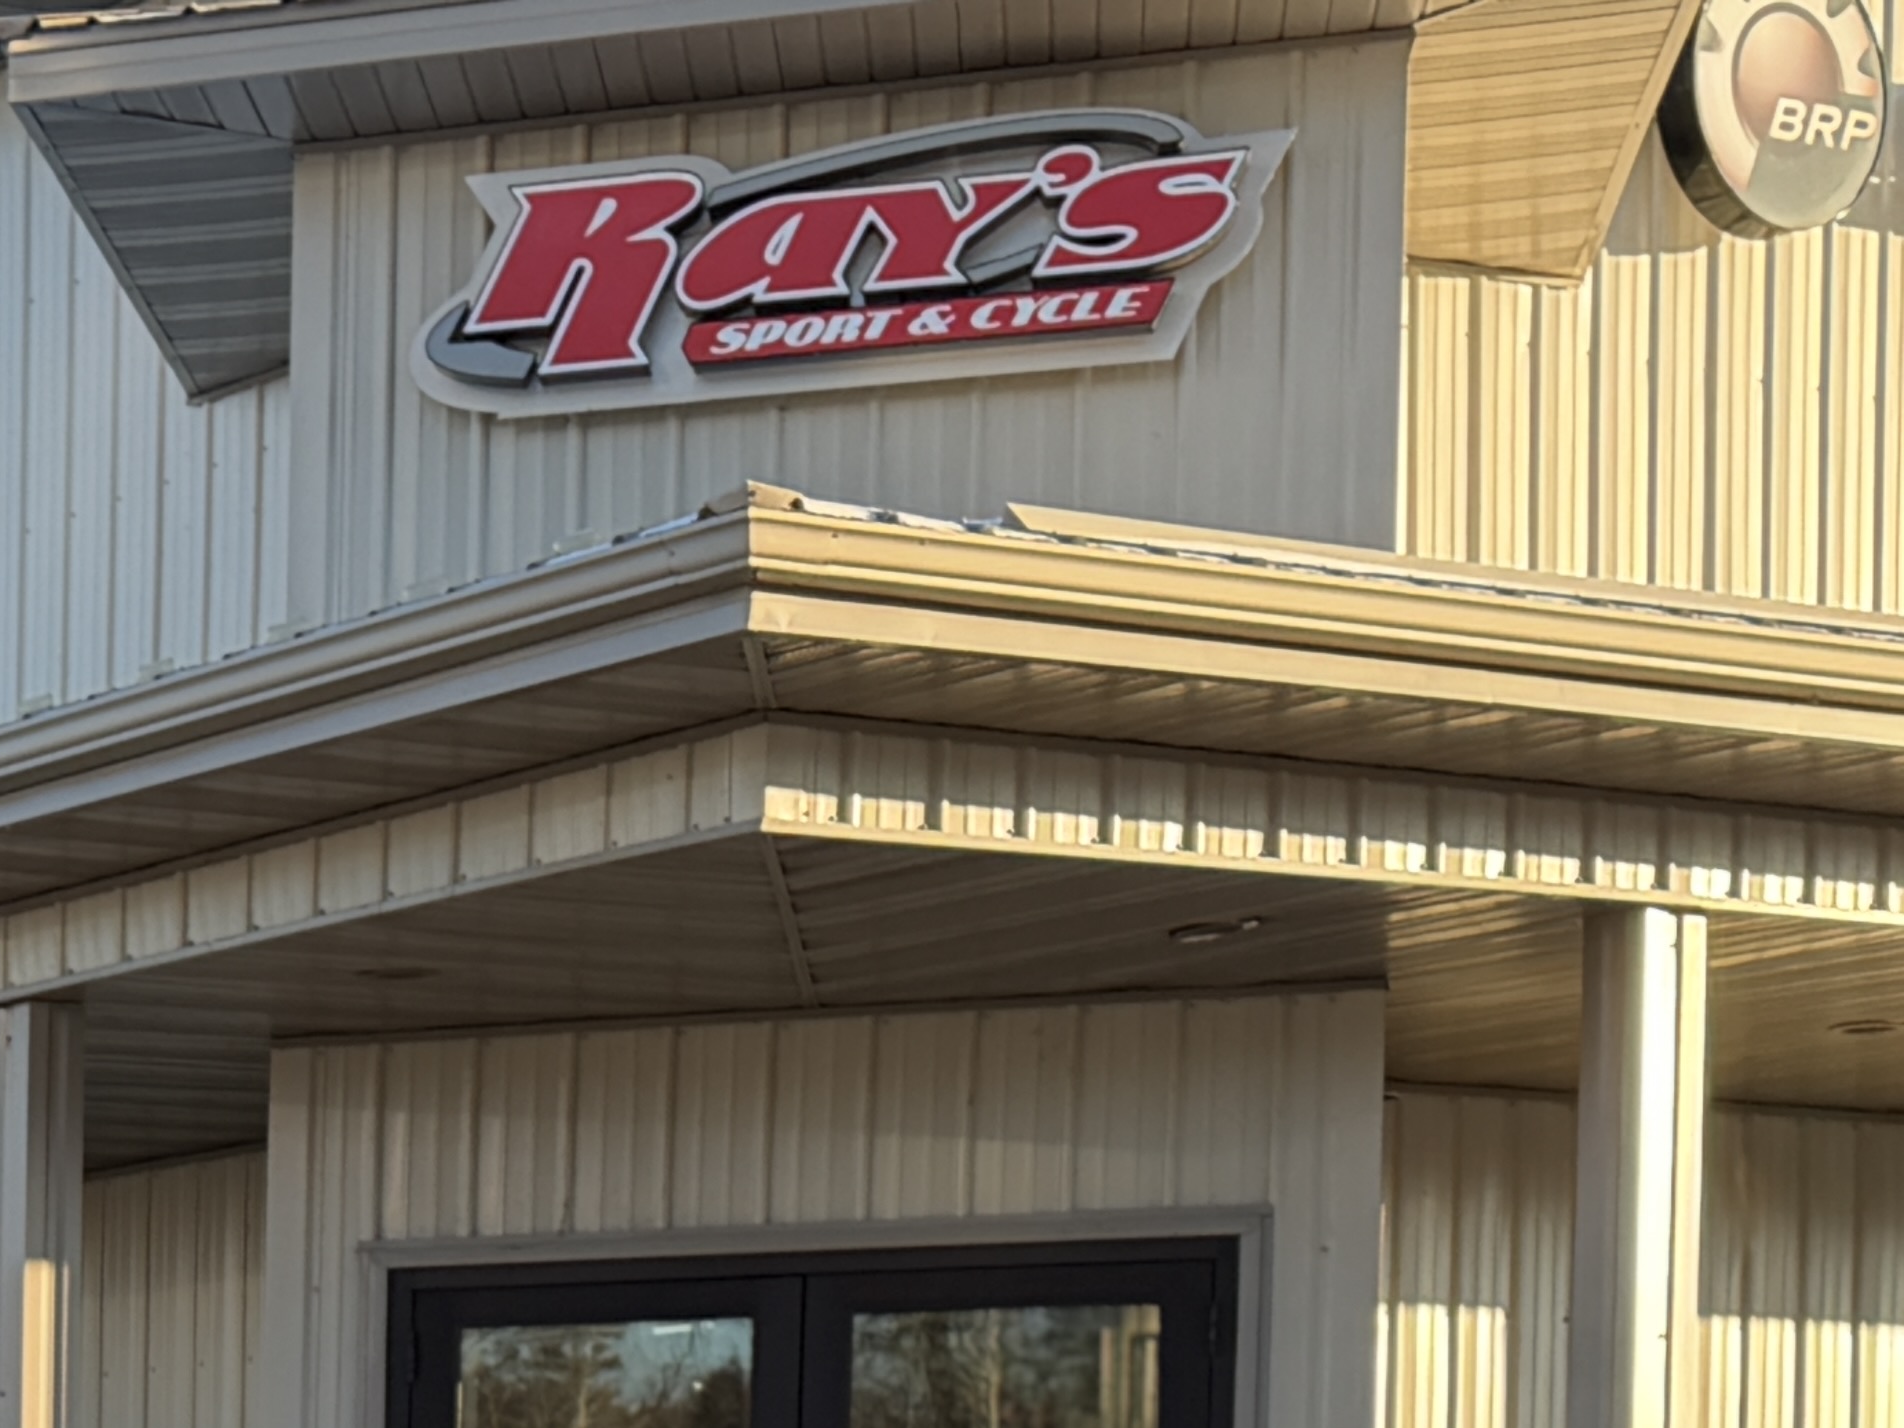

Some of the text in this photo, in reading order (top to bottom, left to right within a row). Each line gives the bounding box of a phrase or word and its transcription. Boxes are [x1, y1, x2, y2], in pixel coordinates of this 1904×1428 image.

[1769, 97, 1878, 151] BRP
[710, 286, 1149, 356] SPORT & CYCLE
